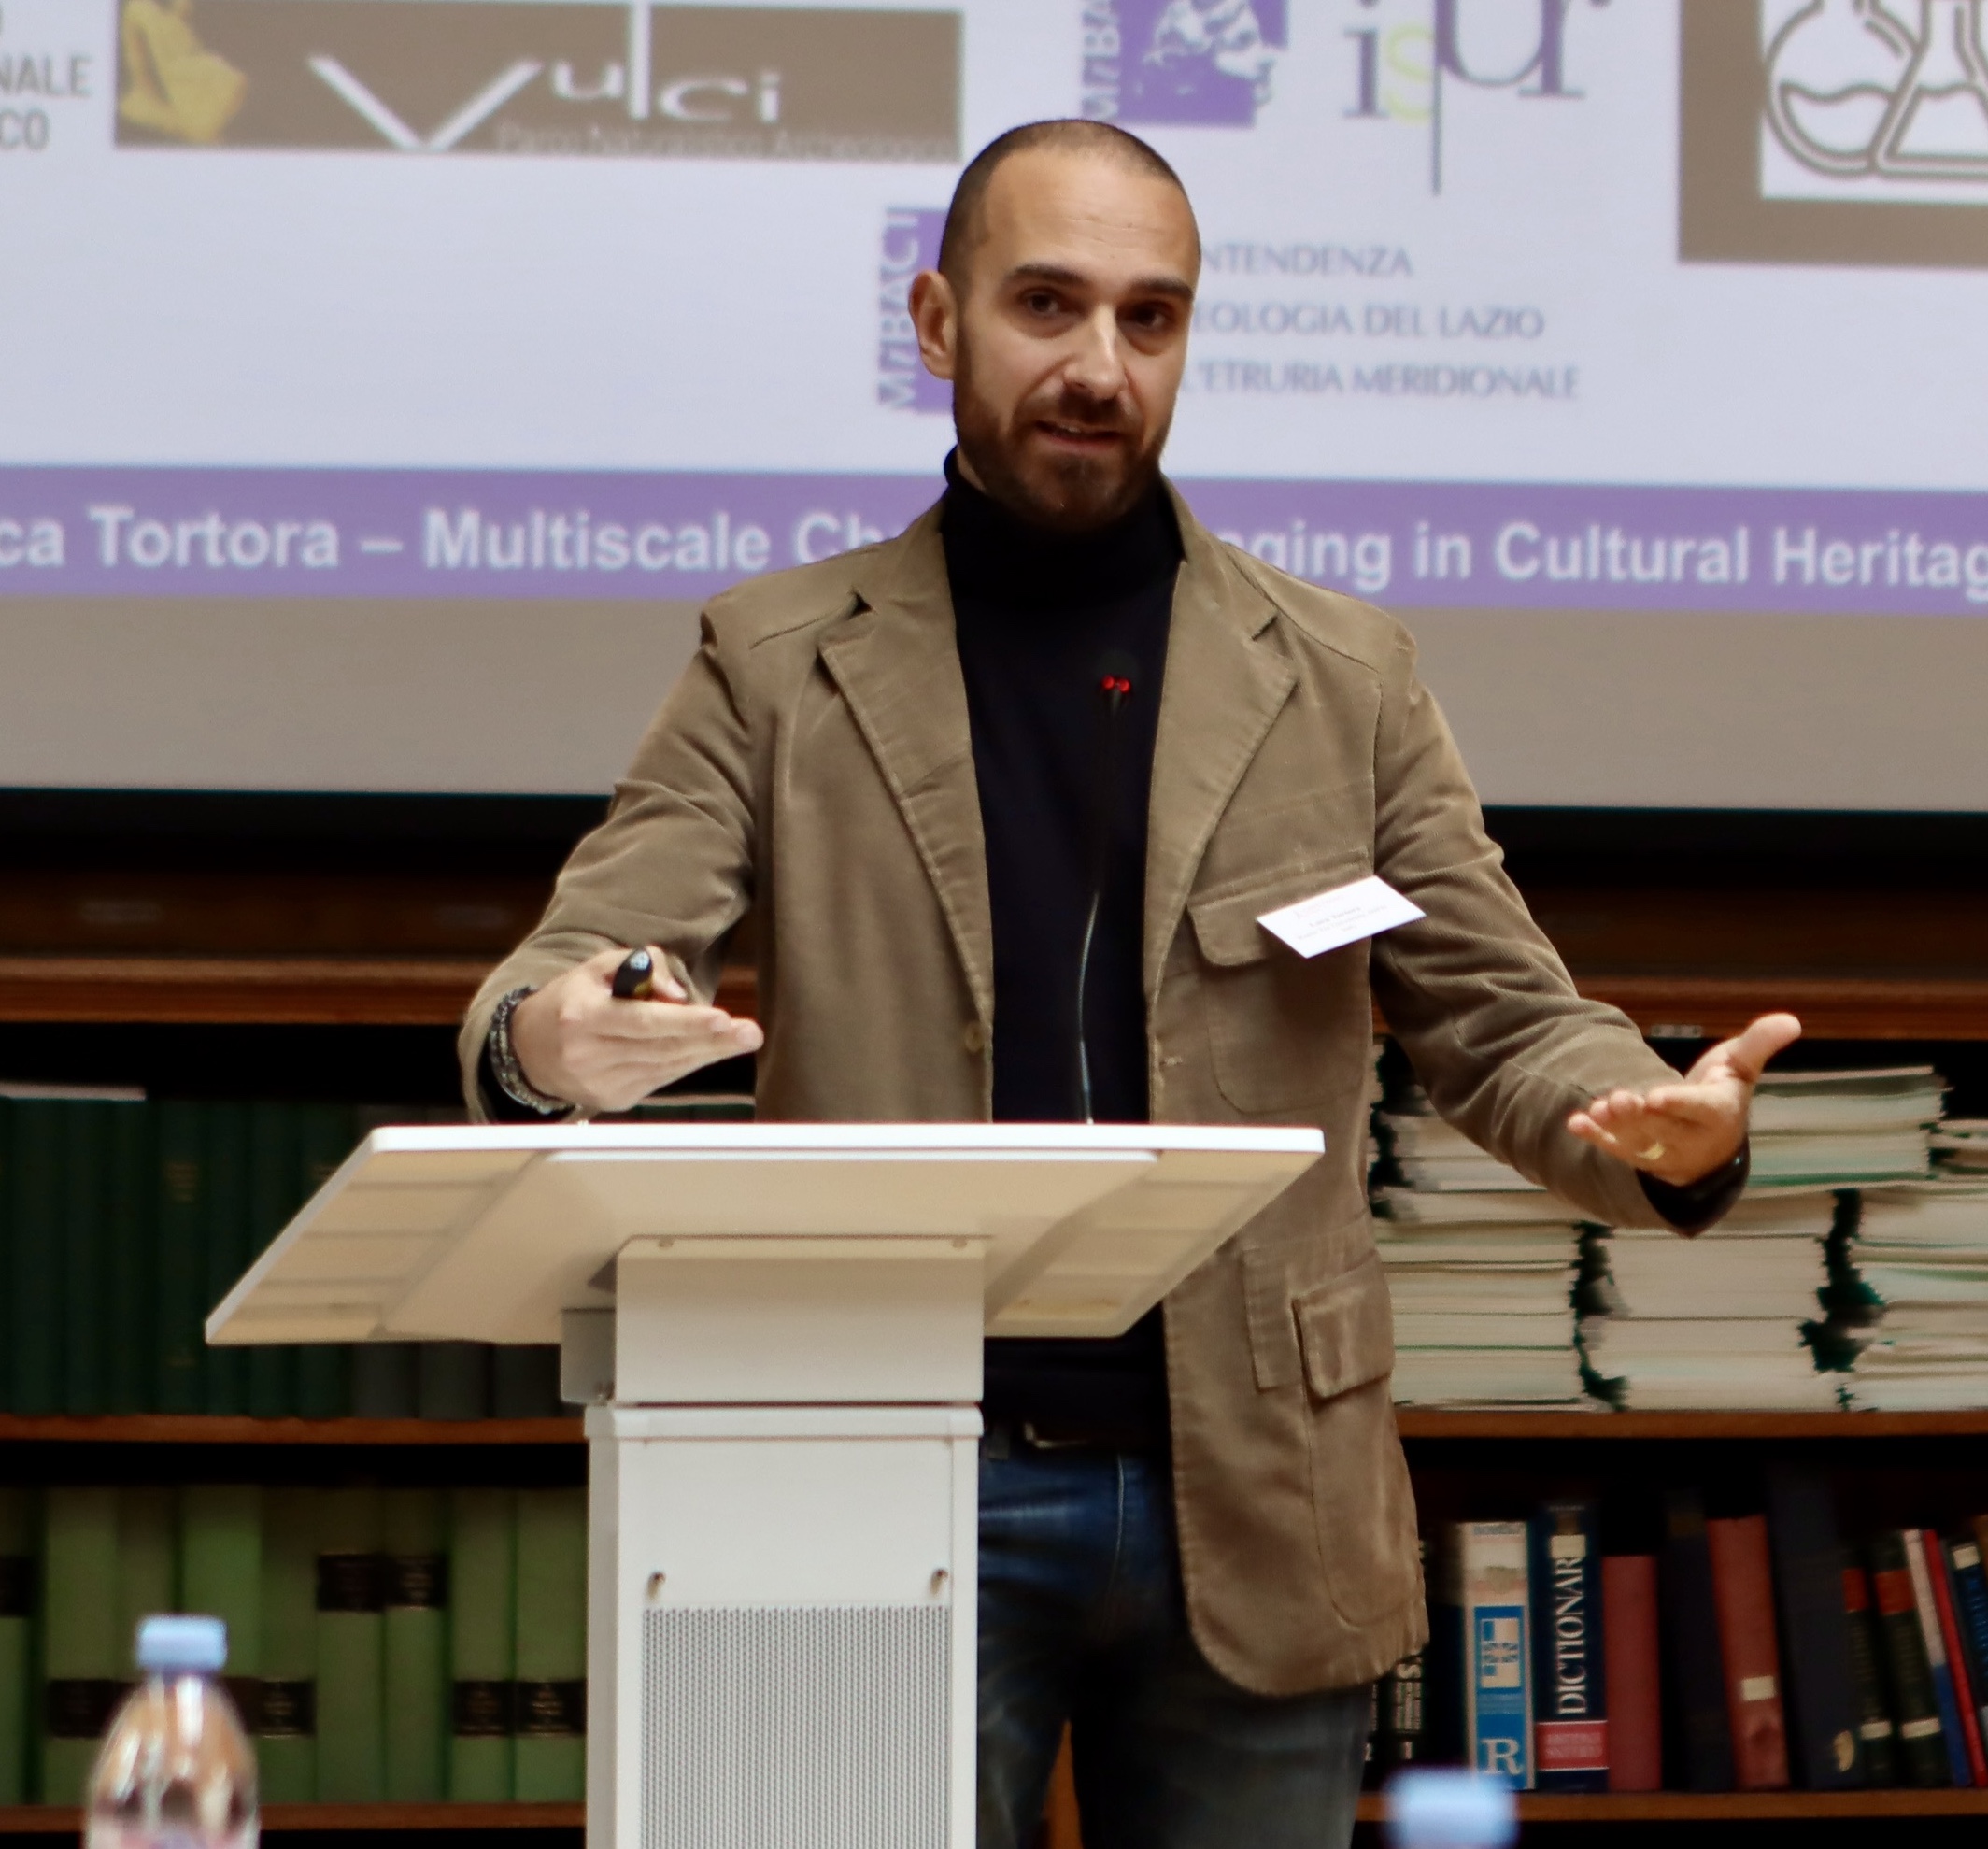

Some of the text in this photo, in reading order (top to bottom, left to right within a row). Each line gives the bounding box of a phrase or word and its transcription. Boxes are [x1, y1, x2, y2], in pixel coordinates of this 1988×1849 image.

[1364, 304, 1427, 337] DEL
[1440, 306, 1546, 340] LAZIO
[1352, 363, 1580, 399] MERIDIONALE
[88, 505, 340, 569] Tortora
[425, 507, 772, 571] Multiscale
[1414, 519, 1473, 579] in
[1496, 520, 1750, 582] Cultural
[1481, 1738, 1524, 1775] R
